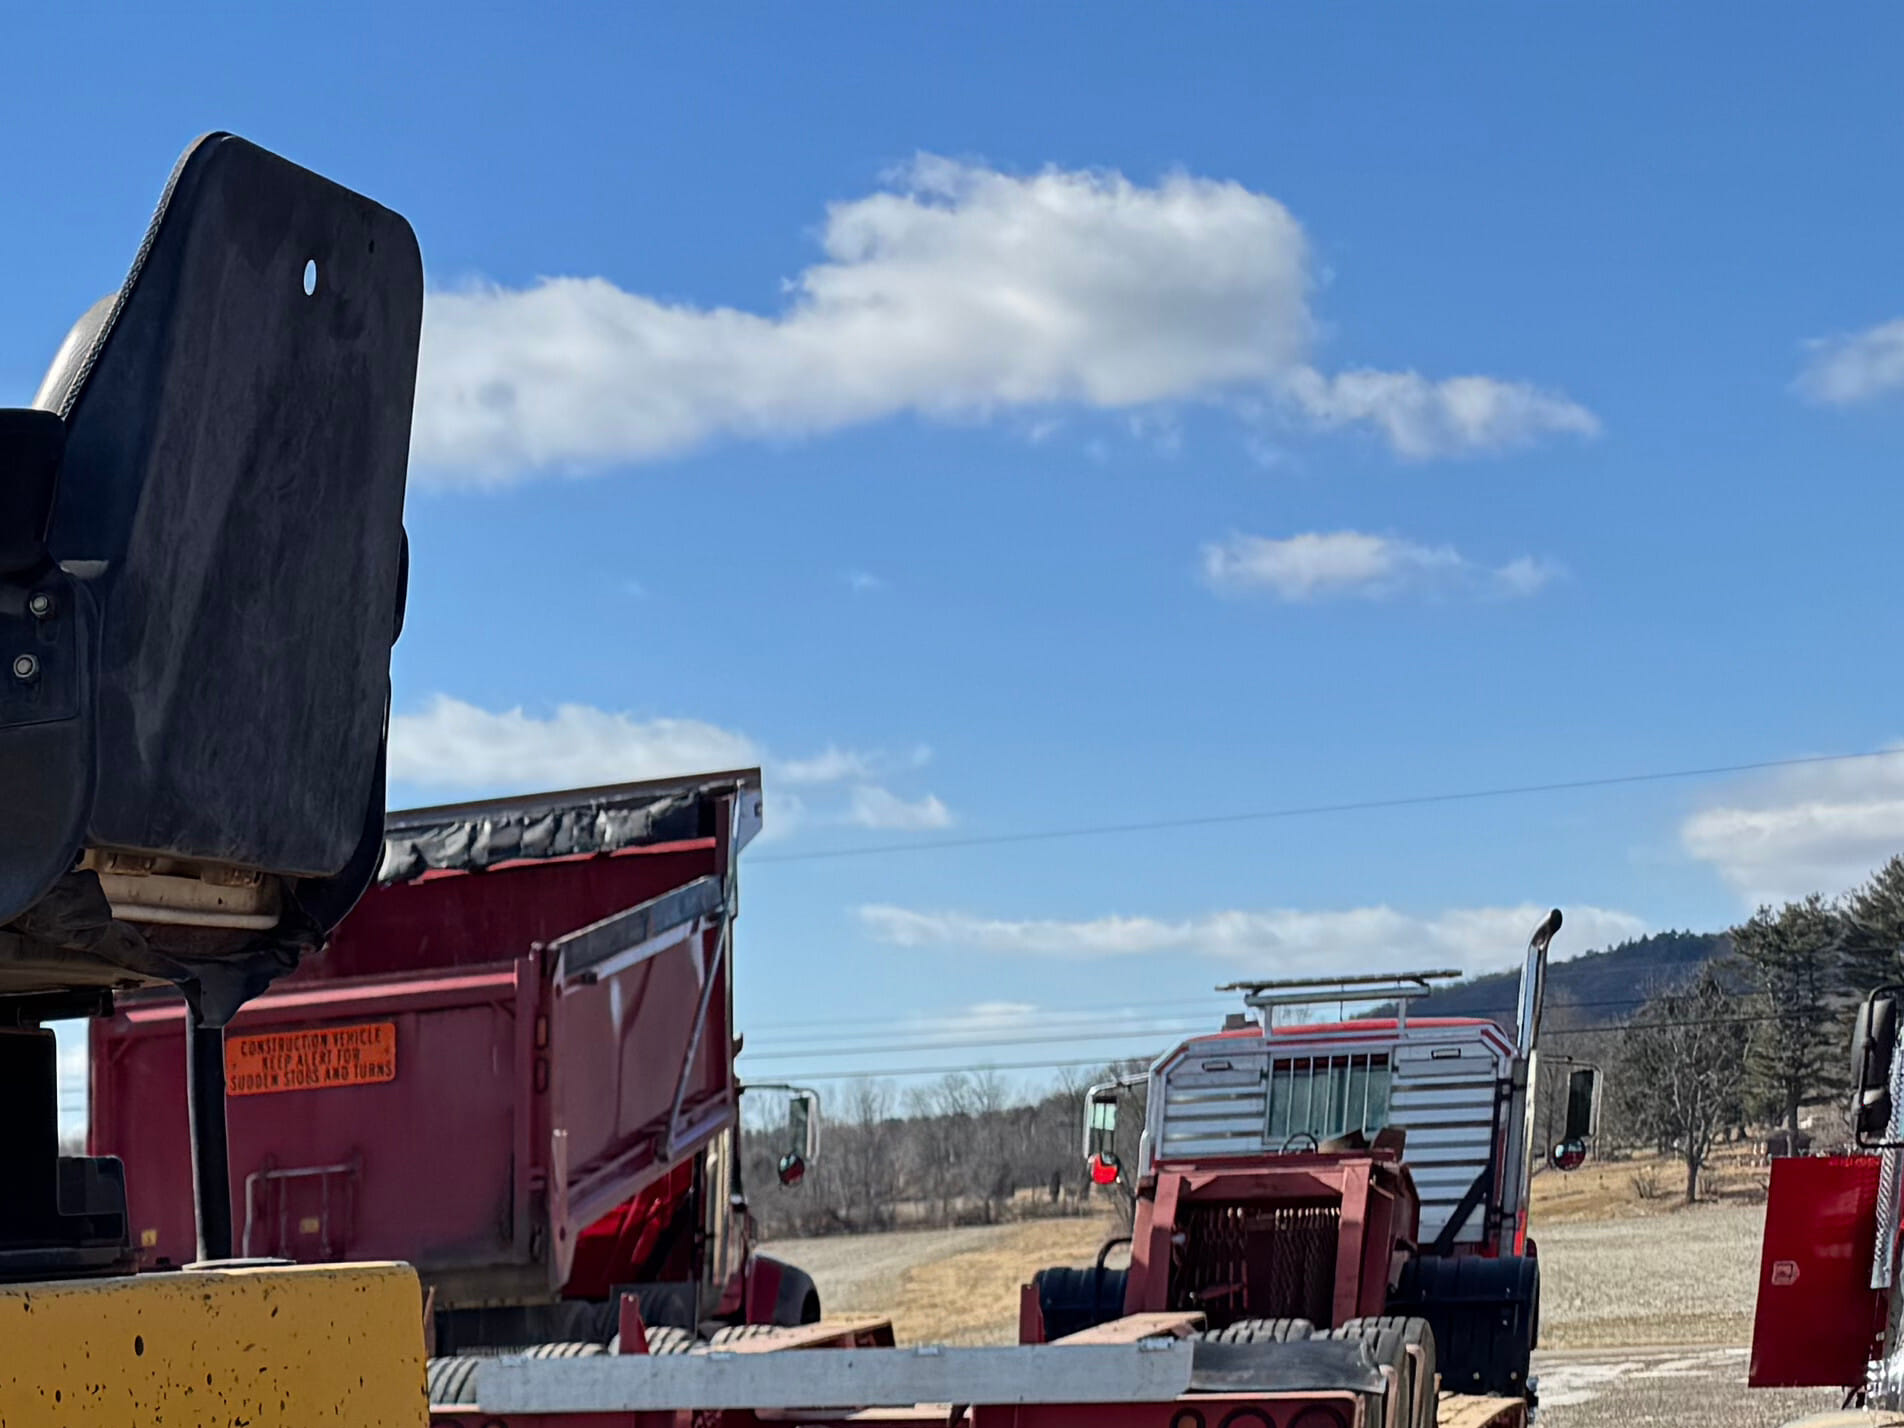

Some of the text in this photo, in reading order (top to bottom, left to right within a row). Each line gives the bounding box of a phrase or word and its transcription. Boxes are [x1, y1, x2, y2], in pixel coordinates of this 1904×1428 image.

[240, 1027, 382, 1057] CONSTRUCTION VEHICLE
[262, 1047, 361, 1072] KEEP ALERT FOR
[230, 1071, 279, 1092] SUDDEN
[324, 1065, 350, 1082] AND
[354, 1059, 393, 1080] TURNS
